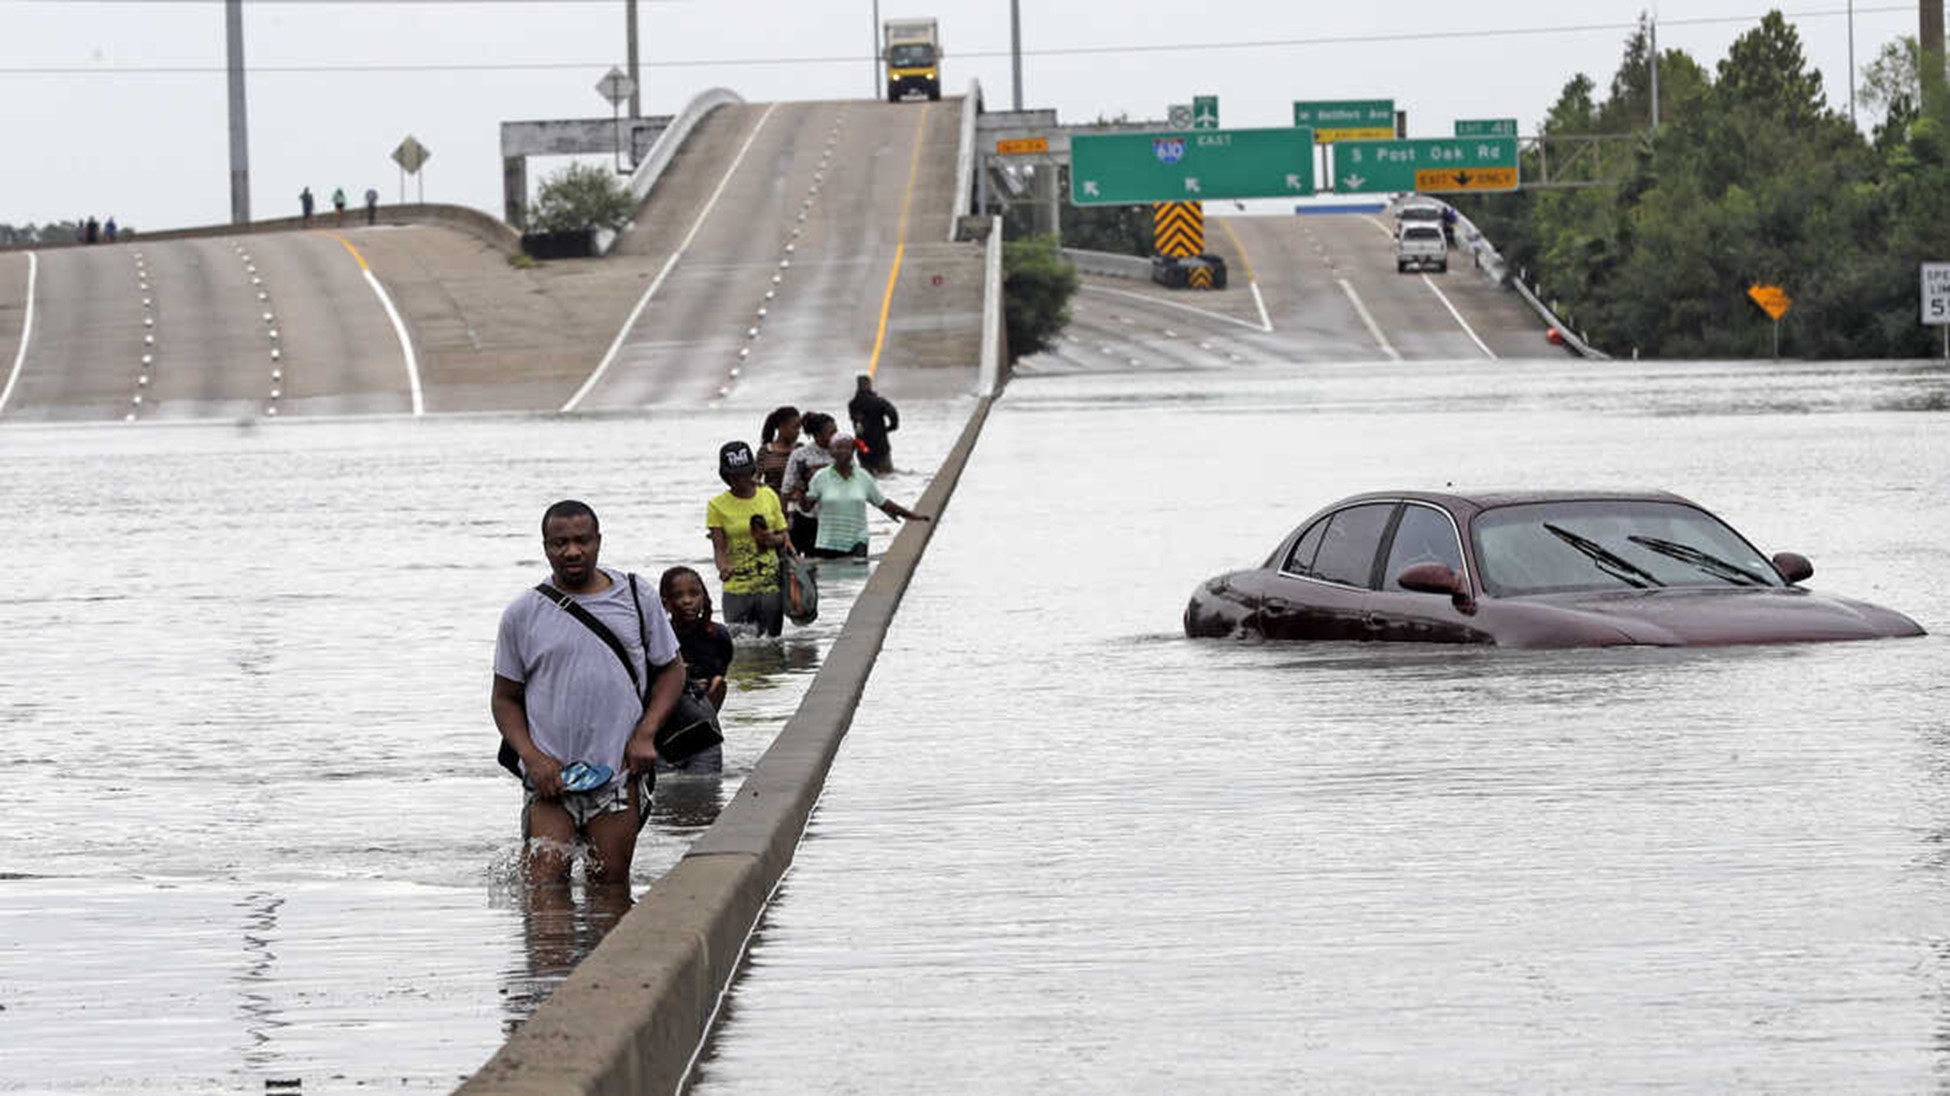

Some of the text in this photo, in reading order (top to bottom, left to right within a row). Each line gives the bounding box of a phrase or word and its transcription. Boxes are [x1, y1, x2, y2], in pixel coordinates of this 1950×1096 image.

[1197, 134, 1231, 147] EAST
[1157, 142, 1183, 159] 610
[1353, 145, 1500, 162] S Post Oak Rd
[1419, 173, 1447, 185] EXIT
